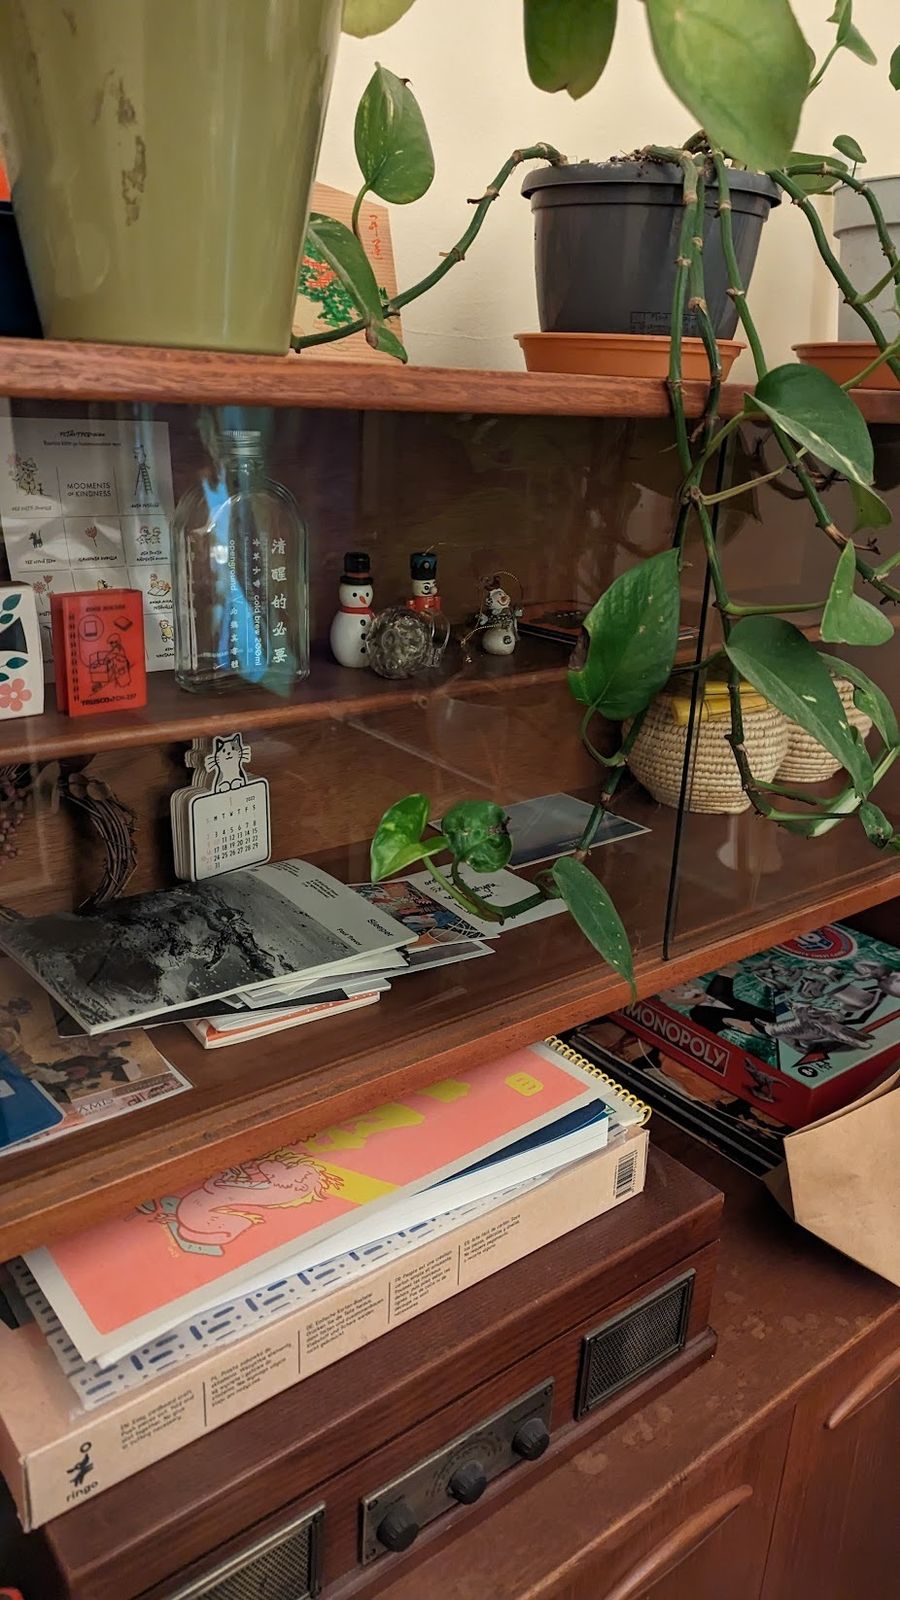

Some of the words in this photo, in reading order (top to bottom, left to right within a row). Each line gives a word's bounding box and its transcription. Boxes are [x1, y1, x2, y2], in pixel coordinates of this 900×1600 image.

[228, 540, 236, 590] openground
[626, 1006, 728, 1069] MONOPOLY
[66, 1480, 98, 1502] ringo
